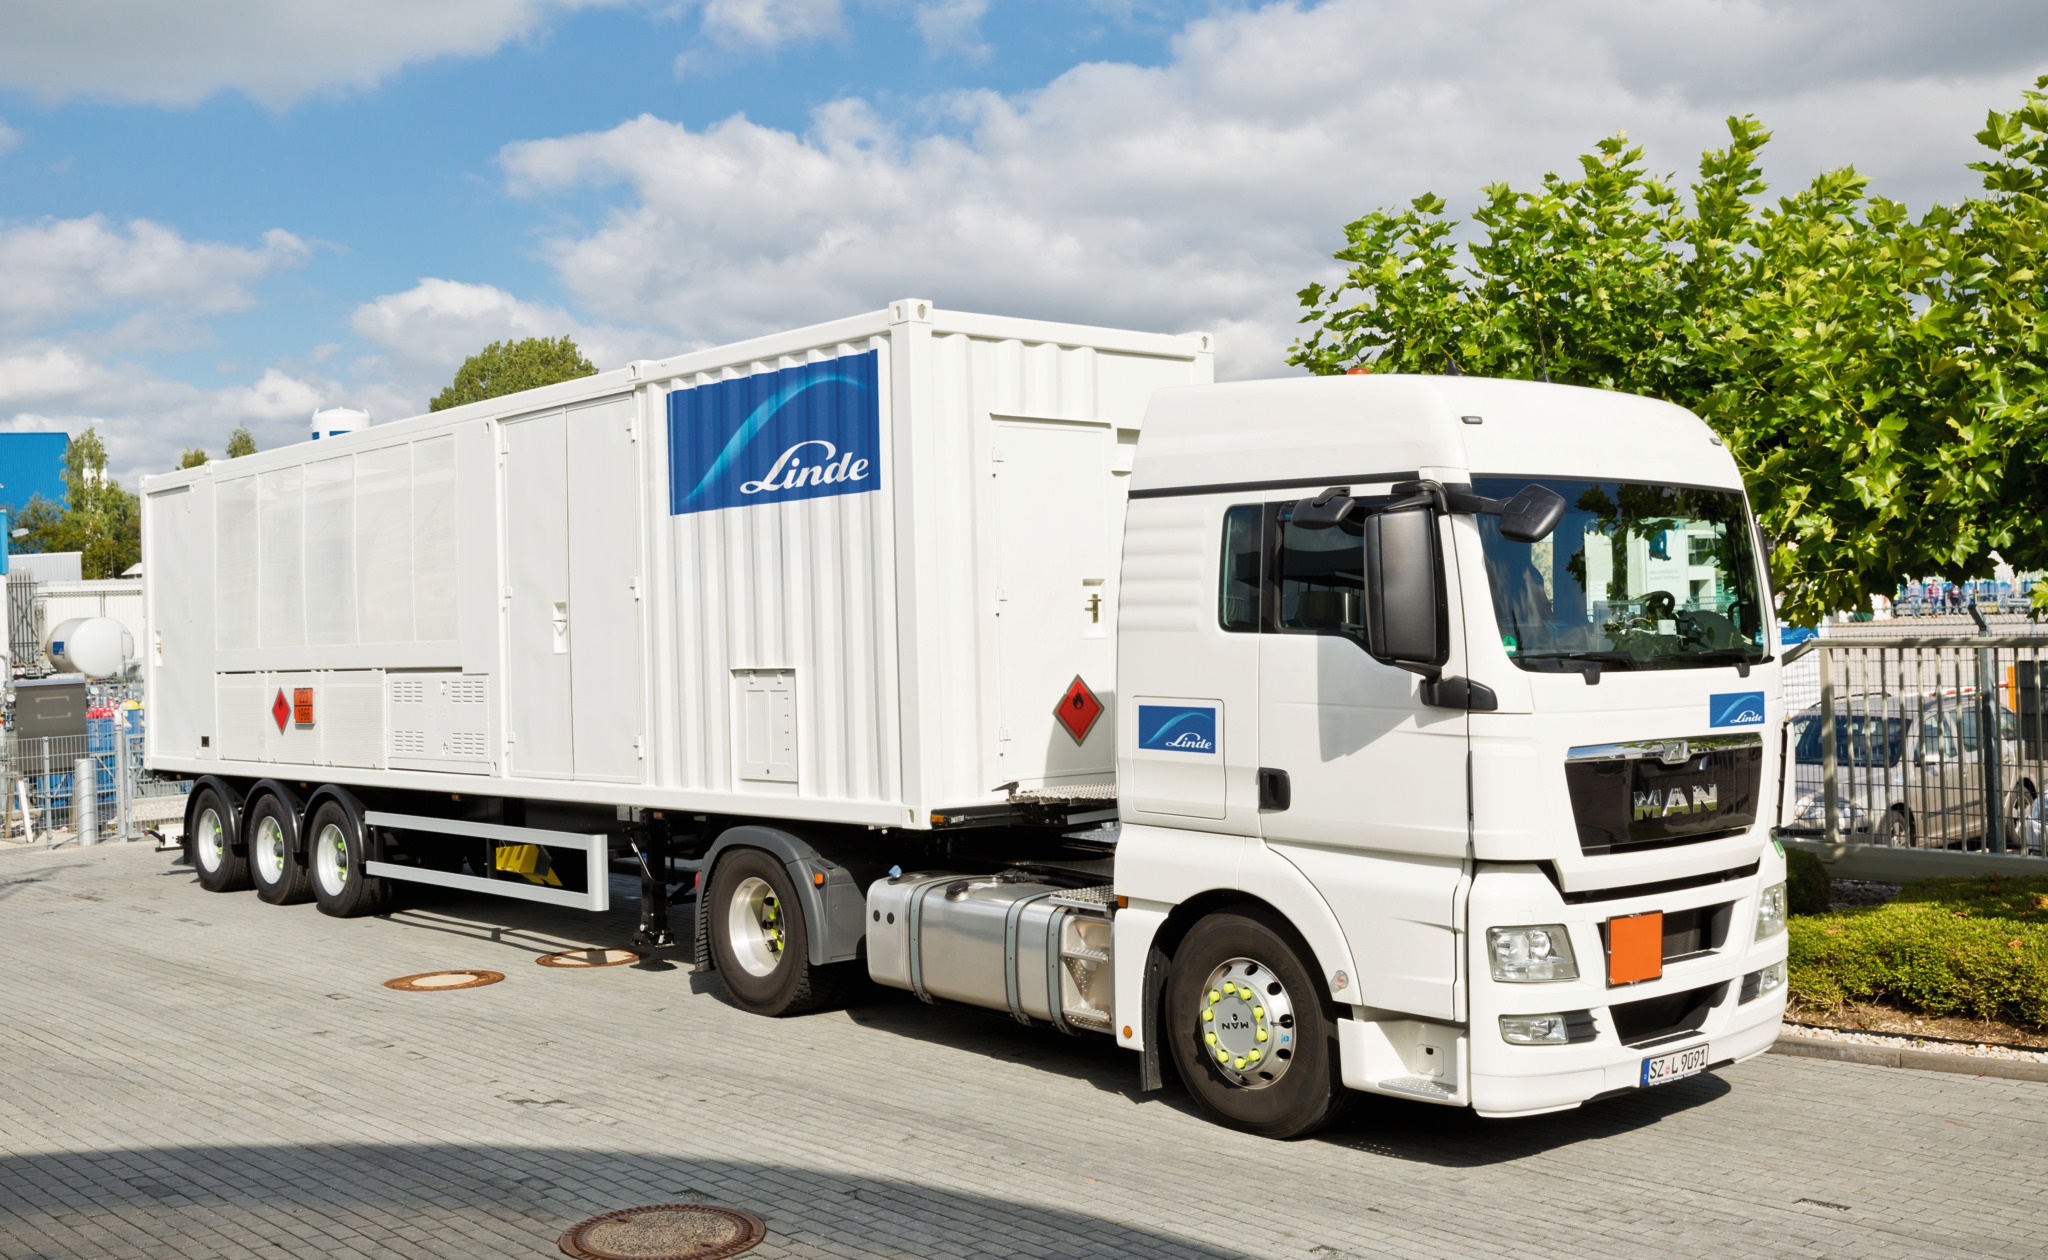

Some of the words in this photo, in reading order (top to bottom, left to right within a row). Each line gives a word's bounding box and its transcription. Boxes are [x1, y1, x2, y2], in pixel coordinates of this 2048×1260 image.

[740, 439, 869, 495] Linde
[1729, 709, 1763, 724] Linde
[1165, 731, 1212, 750] Linde
[1632, 783, 1718, 821] MAN
[1221, 1021, 1249, 1030] MAN
[1649, 1059, 1665, 1080] SZ
[1671, 1057, 1679, 1074] L
[1681, 1048, 1706, 1072] 9091
